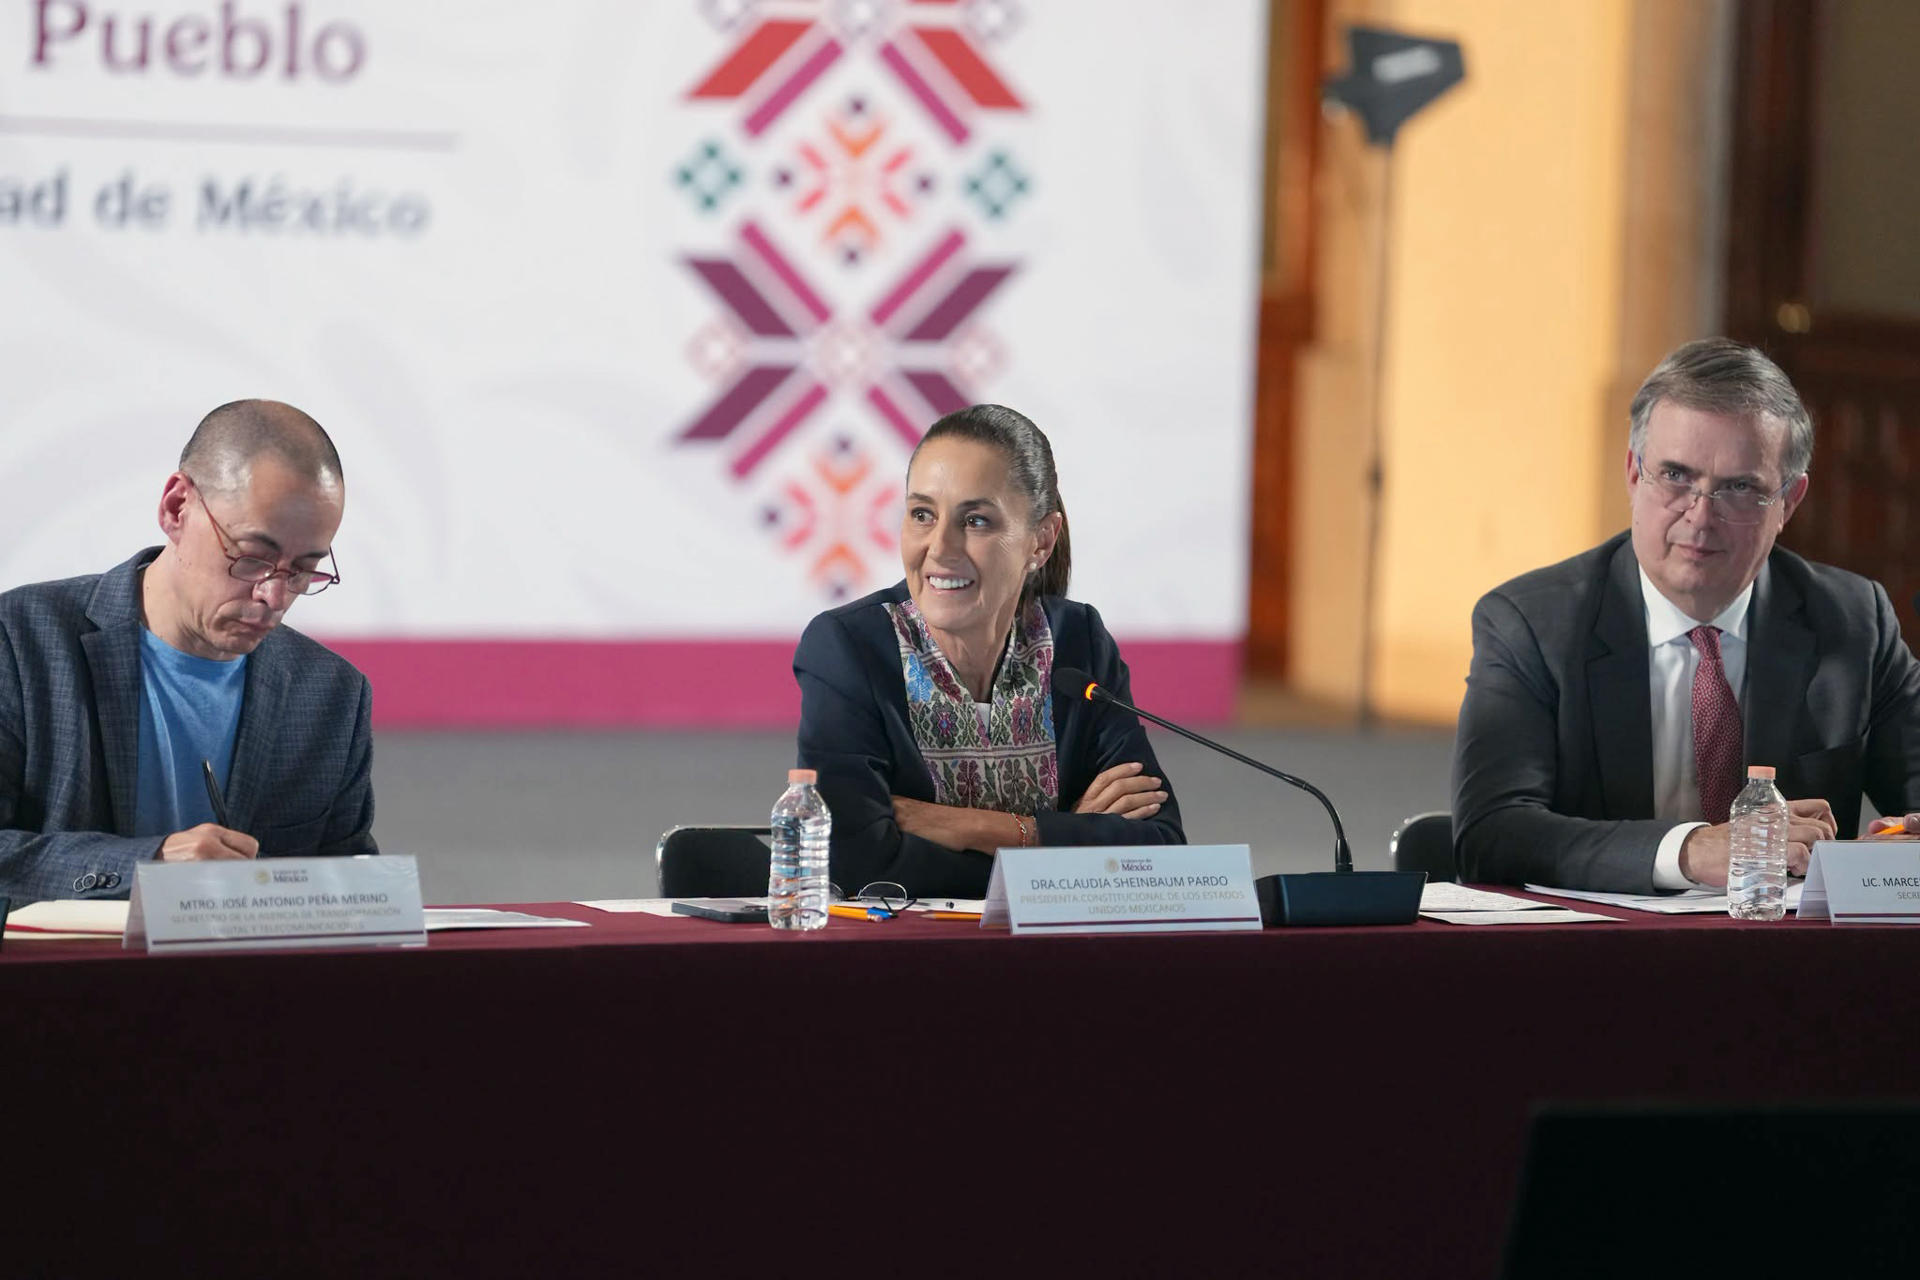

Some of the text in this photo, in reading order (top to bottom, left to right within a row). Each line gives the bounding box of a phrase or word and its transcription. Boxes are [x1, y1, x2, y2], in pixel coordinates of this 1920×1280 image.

[28, 0, 369, 85] Pueblo
[93, 166, 172, 229] de
[197, 172, 432, 237] México
[1121, 862, 1153, 872] México
[1113, 876, 1185, 889] SHEINBAUM
[1187, 875, 1228, 887] PARDO
[1862, 877, 1920, 888] LIC. MARCE
[179, 893, 388, 911] MTRO. JOSÉ ANTONIO PEÑA MERINO
[1020, 890, 1245, 905] PRESIDENTA CONSTITUCIONAL DE LOS ESTADOS
[1087, 902, 1187, 915] UNIDOS MEXICANOS
